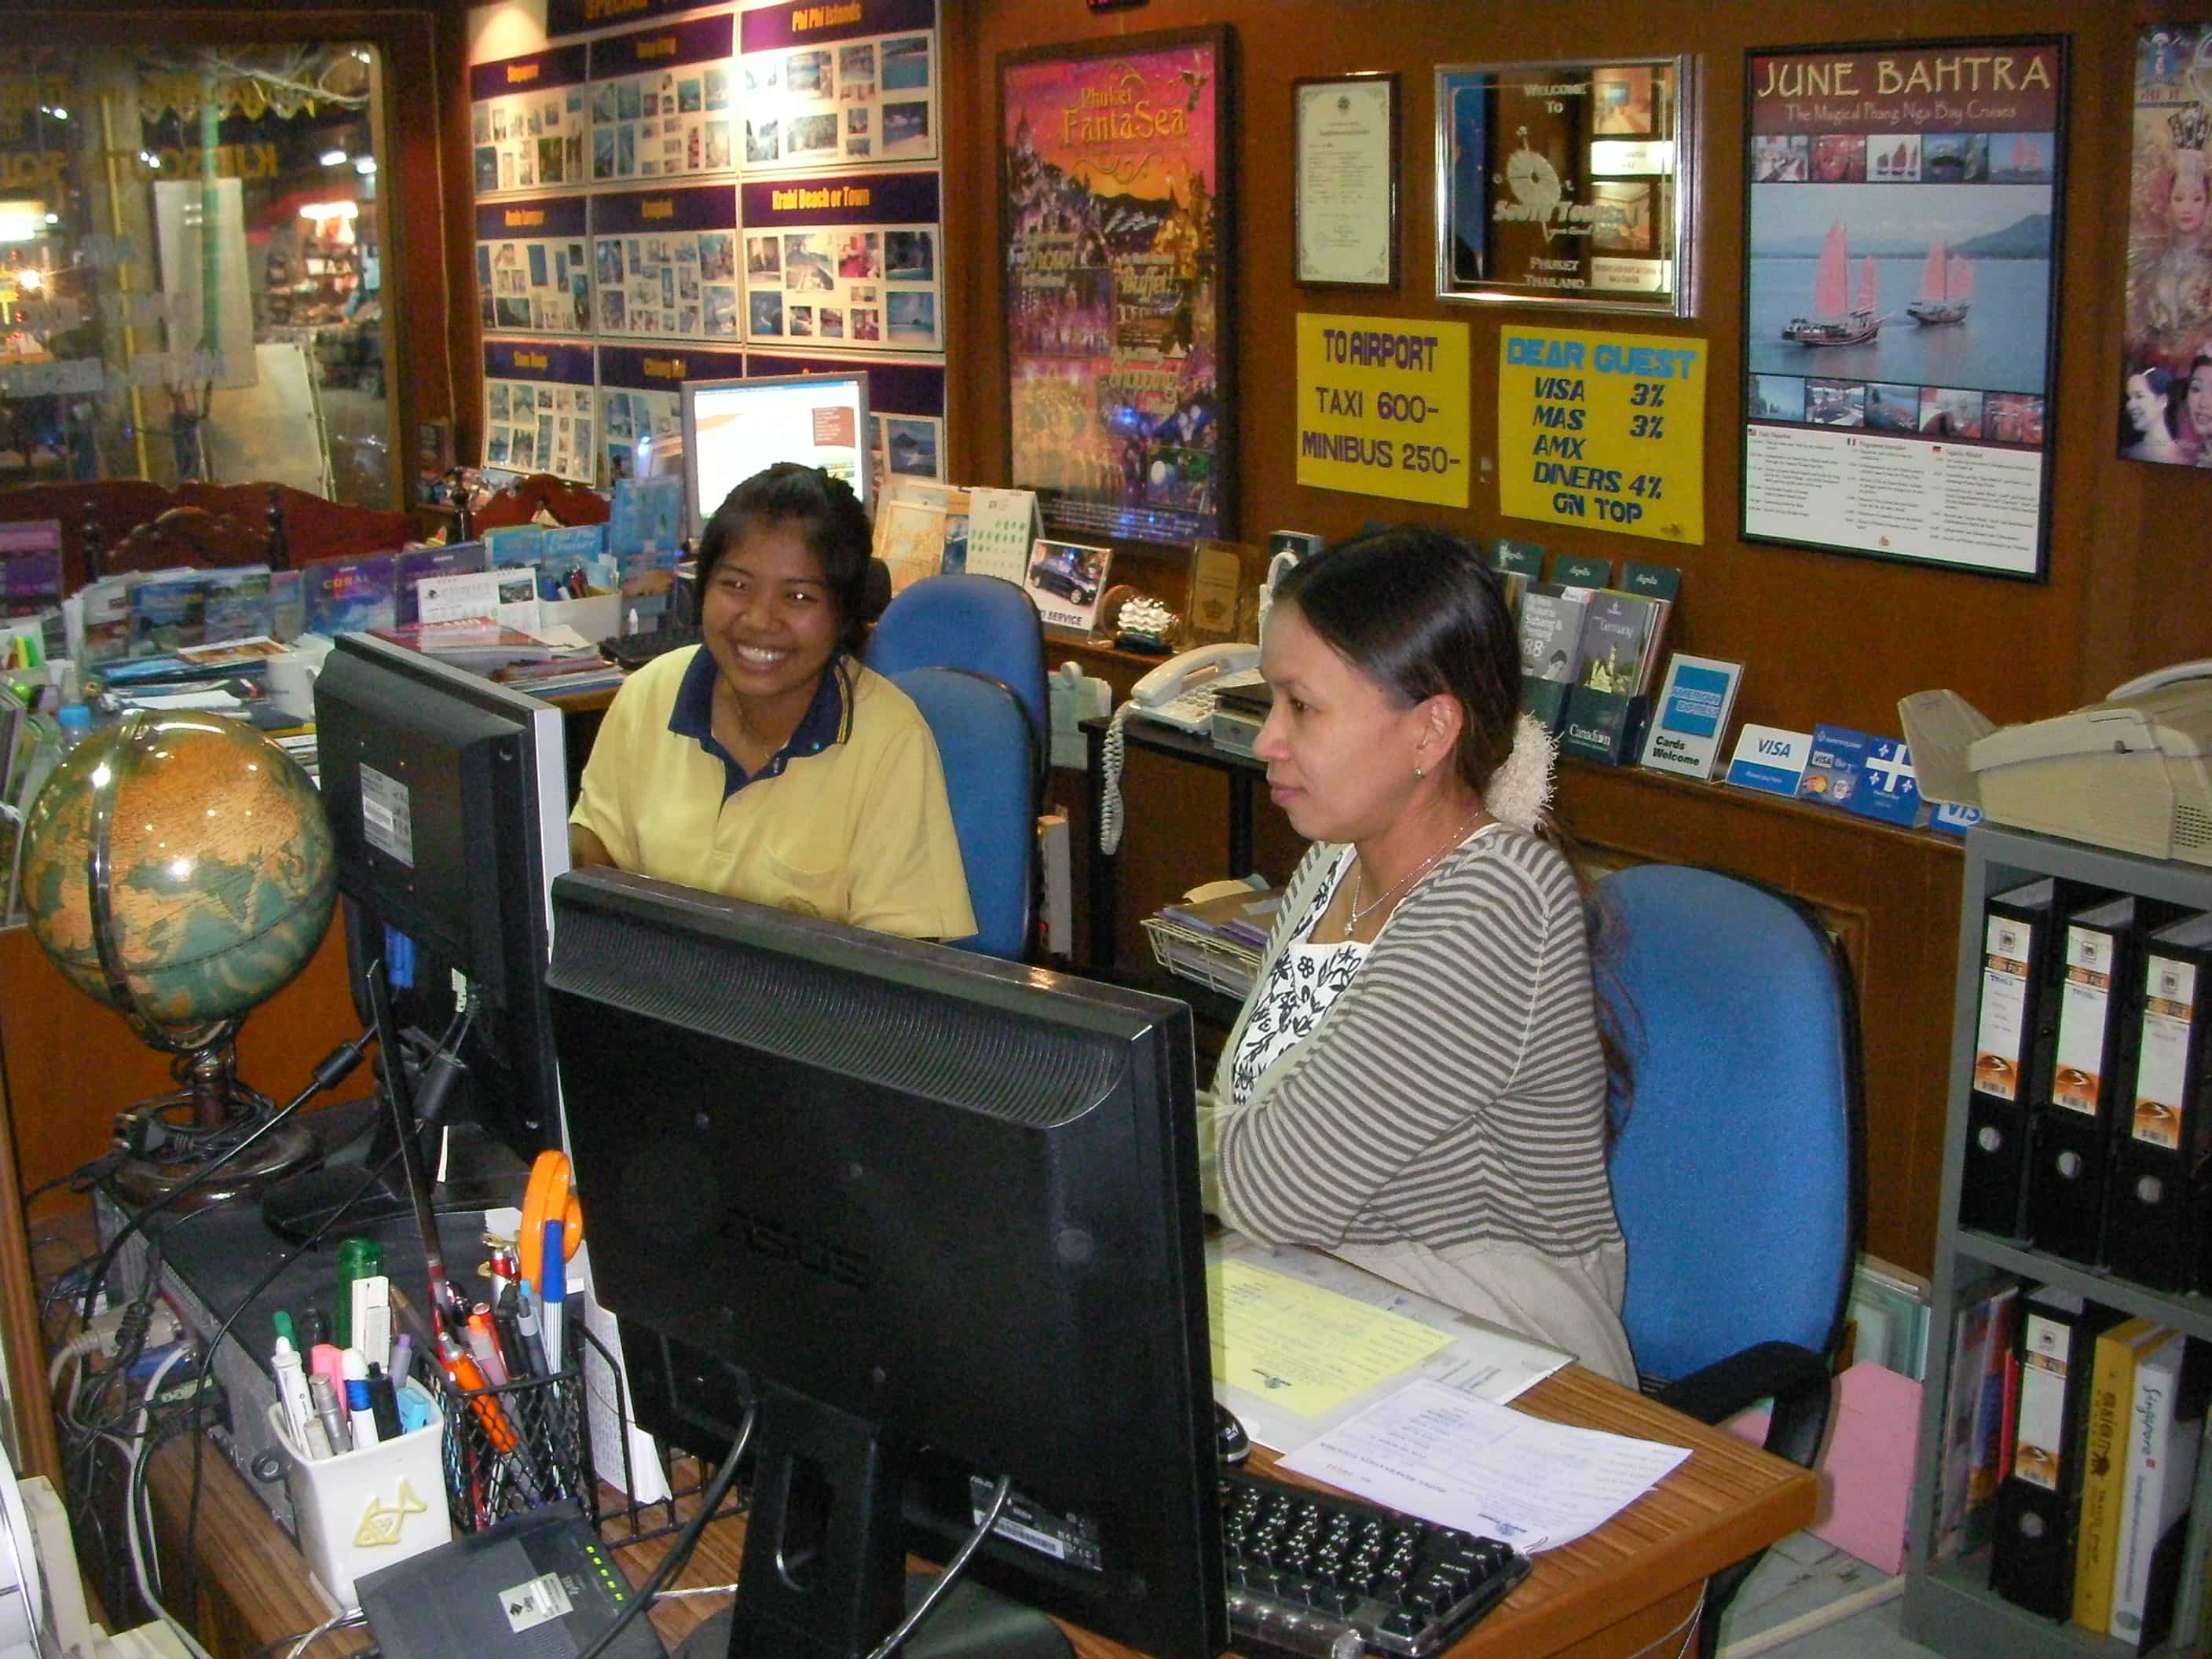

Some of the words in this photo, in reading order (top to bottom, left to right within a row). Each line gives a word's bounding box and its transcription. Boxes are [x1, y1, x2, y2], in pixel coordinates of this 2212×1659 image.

[1757, 60, 1860, 99] JUNE
[1876, 55, 2051, 96] BAHTRA
[1080, 86, 1132, 108] Phuket
[1062, 100, 1188, 145] FantaSea
[1785, 104, 1811, 122] The
[1814, 103, 1861, 126] Magical
[1863, 101, 1900, 126] Phang
[1903, 102, 1931, 124] Nga
[1934, 101, 1964, 125] Bay
[1965, 100, 2018, 119] Cruises
[799, 187, 830, 210] Beach
[830, 189, 842, 207] or
[843, 185, 870, 207] Town
[1324, 328, 1347, 363] TO
[1350, 331, 1438, 372] AIRPORT
[1507, 337, 1586, 370] DEAR
[1593, 344, 1697, 379] GUEST
[1315, 386, 1364, 418] TAXI
[1534, 376, 1584, 402] VISA
[1630, 383, 1665, 407] 3%
[1533, 405, 1586, 431] MAS
[1629, 415, 1664, 439] 3%
[1302, 430, 1393, 468] MINIBUS
[1533, 434, 1587, 460] AMX
[1533, 461, 1623, 493] DINERS
[1628, 474, 1663, 500] 4%
[1595, 497, 1643, 525] TOP
[1047, 610, 1082, 626] SERVICE
[1569, 723, 1611, 746] Canadian
[1655, 734, 1687, 751] Cards
[1652, 747, 1701, 767] Welcome
[1757, 738, 1792, 759] VISA
[1814, 753, 1833, 767] VISA
[1947, 804, 1982, 822] VIS
